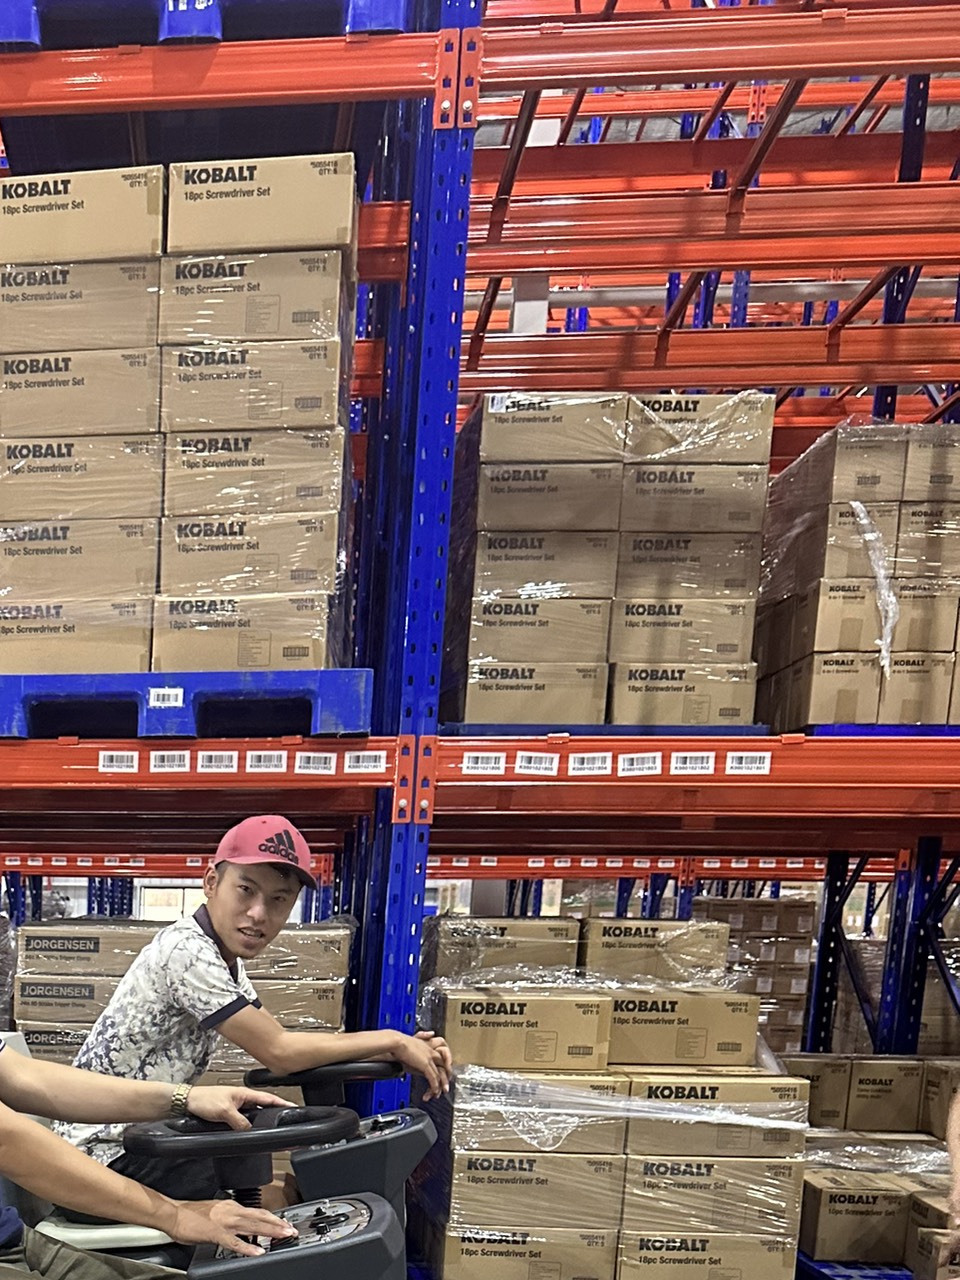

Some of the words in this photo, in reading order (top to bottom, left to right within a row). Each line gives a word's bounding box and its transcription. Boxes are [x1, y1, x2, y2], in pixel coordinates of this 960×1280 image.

[184, 165, 257, 185] KOBALT
[2, 179, 71, 199] KOBALT
[184, 191, 204, 201] 18pc
[206, 188, 254, 199] Screwdriver
[256, 186, 270, 196] Set
[2, 205, 21, 216] 18pc
[22, 202, 69, 212] Screwdriver
[71, 200, 84, 209] Set
[175, 263, 247, 280] KOBALT
[1, 270, 70, 287] KOBALT
[175, 286, 194, 296] 18pc
[247, 282, 260, 291] Set
[1, 293, 20, 303] 18pc
[22, 292, 68, 301] Screwdriver
[70, 291, 82, 299] Set
[177, 350, 249, 367] KOBALT
[3, 357, 72, 375] KOBALT
[248, 370, 261, 379] Set
[24, 378, 70, 389] Screwdriver
[72, 377, 85, 386] Set
[641, 400, 700, 412] KOBALT
[6, 443, 74, 460] KOBALT
[181, 437, 252, 454] KOBALT
[27, 464, 73, 473] Screwdriver
[74, 463, 87, 472] Set
[202, 458, 250, 468] Screwdriver
[251, 457, 264, 466] Set
[490, 470, 548, 481] KOBALT
[635, 471, 695, 483] KOBALT
[177, 521, 247, 538] KOBALT
[198, 542, 244, 552] Screwdriver
[246, 541, 259, 550] Set
[488, 537, 544, 549] KOBALT
[632, 539, 691, 550] KOBALT
[4, 547, 22, 556] 18pc
[23, 546, 68, 555] Screwdriver
[70, 545, 82, 554] Set
[168, 599, 238, 615] KOBALT
[483, 604, 539, 615] KOBALT
[625, 604, 683, 616] KOBALT
[16, 624, 61, 634] Screwdriver
[62, 624, 75, 632] Set
[237, 619, 250, 628] Set
[894, 659, 925, 667] KOBALT
[479, 668, 536, 680] KOBALT
[628, 669, 686, 681] KOBALT
[258, 843, 299, 864] adidas
[602, 927, 659, 938] KOBALT
[28, 940, 94, 950] JORGENSEN
[619, 941, 656, 949] Screwdriver
[23, 986, 89, 996] JORGENSEN
[460, 1002, 527, 1015] KOBALT
[614, 1000, 678, 1013] KOBALT
[461, 1020, 478, 1028] 18pc
[479, 1020, 524, 1028] Screwdriver
[525, 1020, 538, 1028] Set
[613, 1017, 629, 1025] 18pc
[632, 1017, 675, 1025] Screwdriver
[858, 1078, 894, 1086] KOBALT
[647, 1086, 719, 1099] KOBALT
[467, 1158, 536, 1172] KOBALT
[642, 1162, 714, 1176] KOBALT
[467, 1176, 485, 1185] 18pc
[487, 1176, 533, 1185] Screwdriver
[535, 1177, 549, 1185] Set
[713, 1182, 727, 1190] Set
[829, 1195, 879, 1205] KOBALT
[640, 1238, 709, 1252] KOBALT
[461, 1248, 478, 1257] 18pc
[480, 1248, 527, 1258] Screwdriver
[529, 1250, 542, 1258] Set
[639, 1256, 657, 1265] 18pc
[659, 1257, 707, 1265] Screwdriver
[709, 1257, 722, 1266] Set
